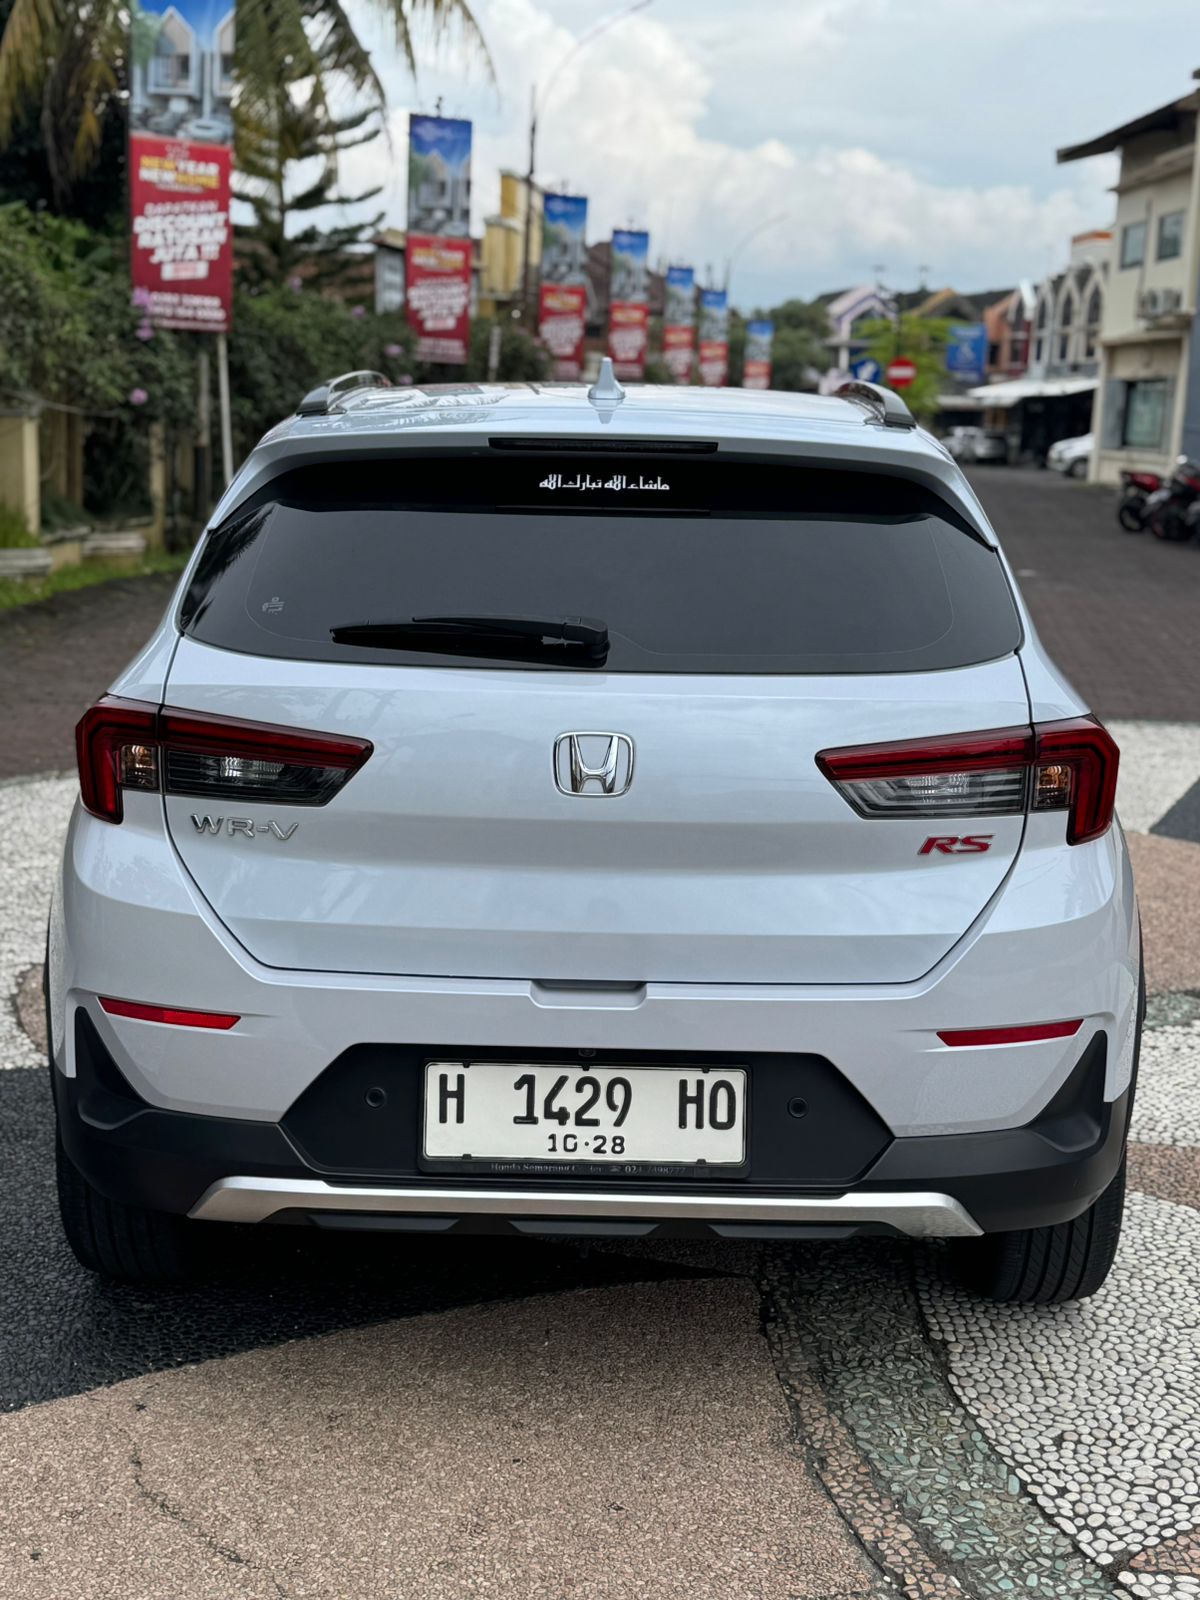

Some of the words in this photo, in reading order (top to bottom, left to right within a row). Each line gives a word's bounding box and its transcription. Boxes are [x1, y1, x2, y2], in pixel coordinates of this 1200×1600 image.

[562, 474, 602, 490] تبارك
[627, 475, 670, 490] ماشاء
[190, 813, 299, 840] WR-V
[917, 834, 995, 855] RS
[439, 1074, 465, 1123] H
[513, 1074, 632, 1127] 1429
[678, 1079, 736, 1130] HO
